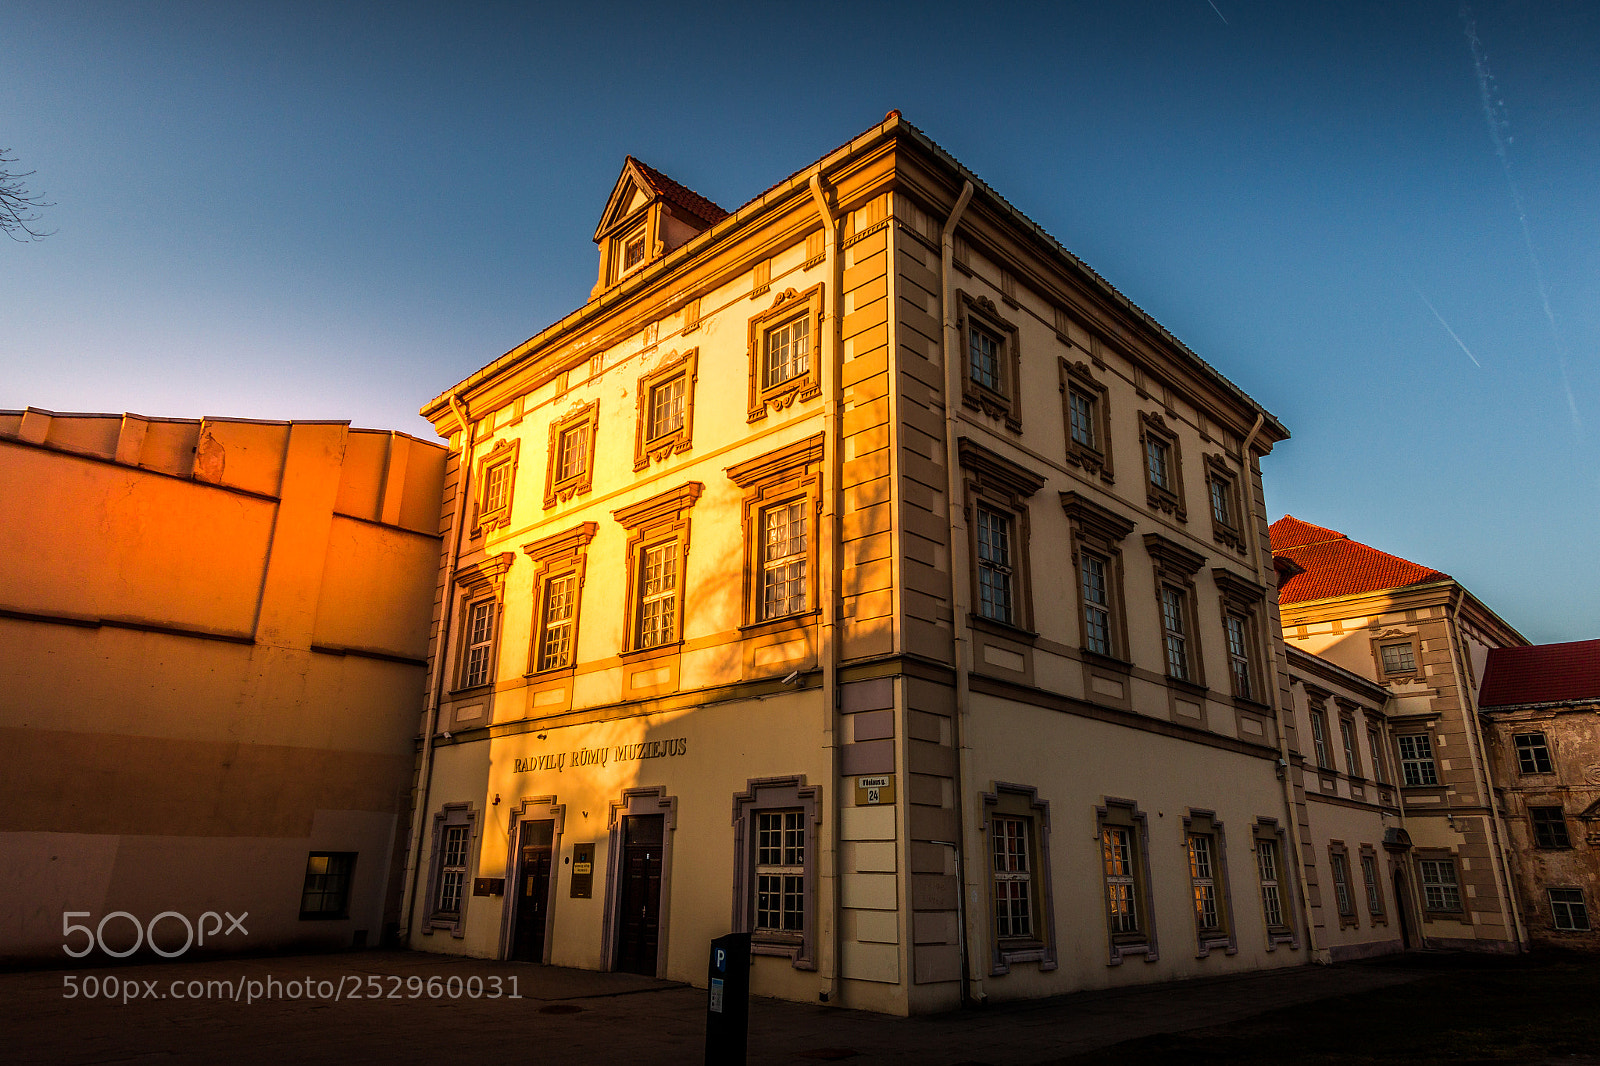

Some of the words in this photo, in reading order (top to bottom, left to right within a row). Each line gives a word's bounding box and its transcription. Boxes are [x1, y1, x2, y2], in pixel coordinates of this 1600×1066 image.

[513, 752, 567, 773] RADVILŲ
[569, 747, 610, 768] RŪMŲ
[614, 737, 688, 762] MUZIEJUS
[869, 790, 878, 801] 24
[717, 949, 725, 967] P
